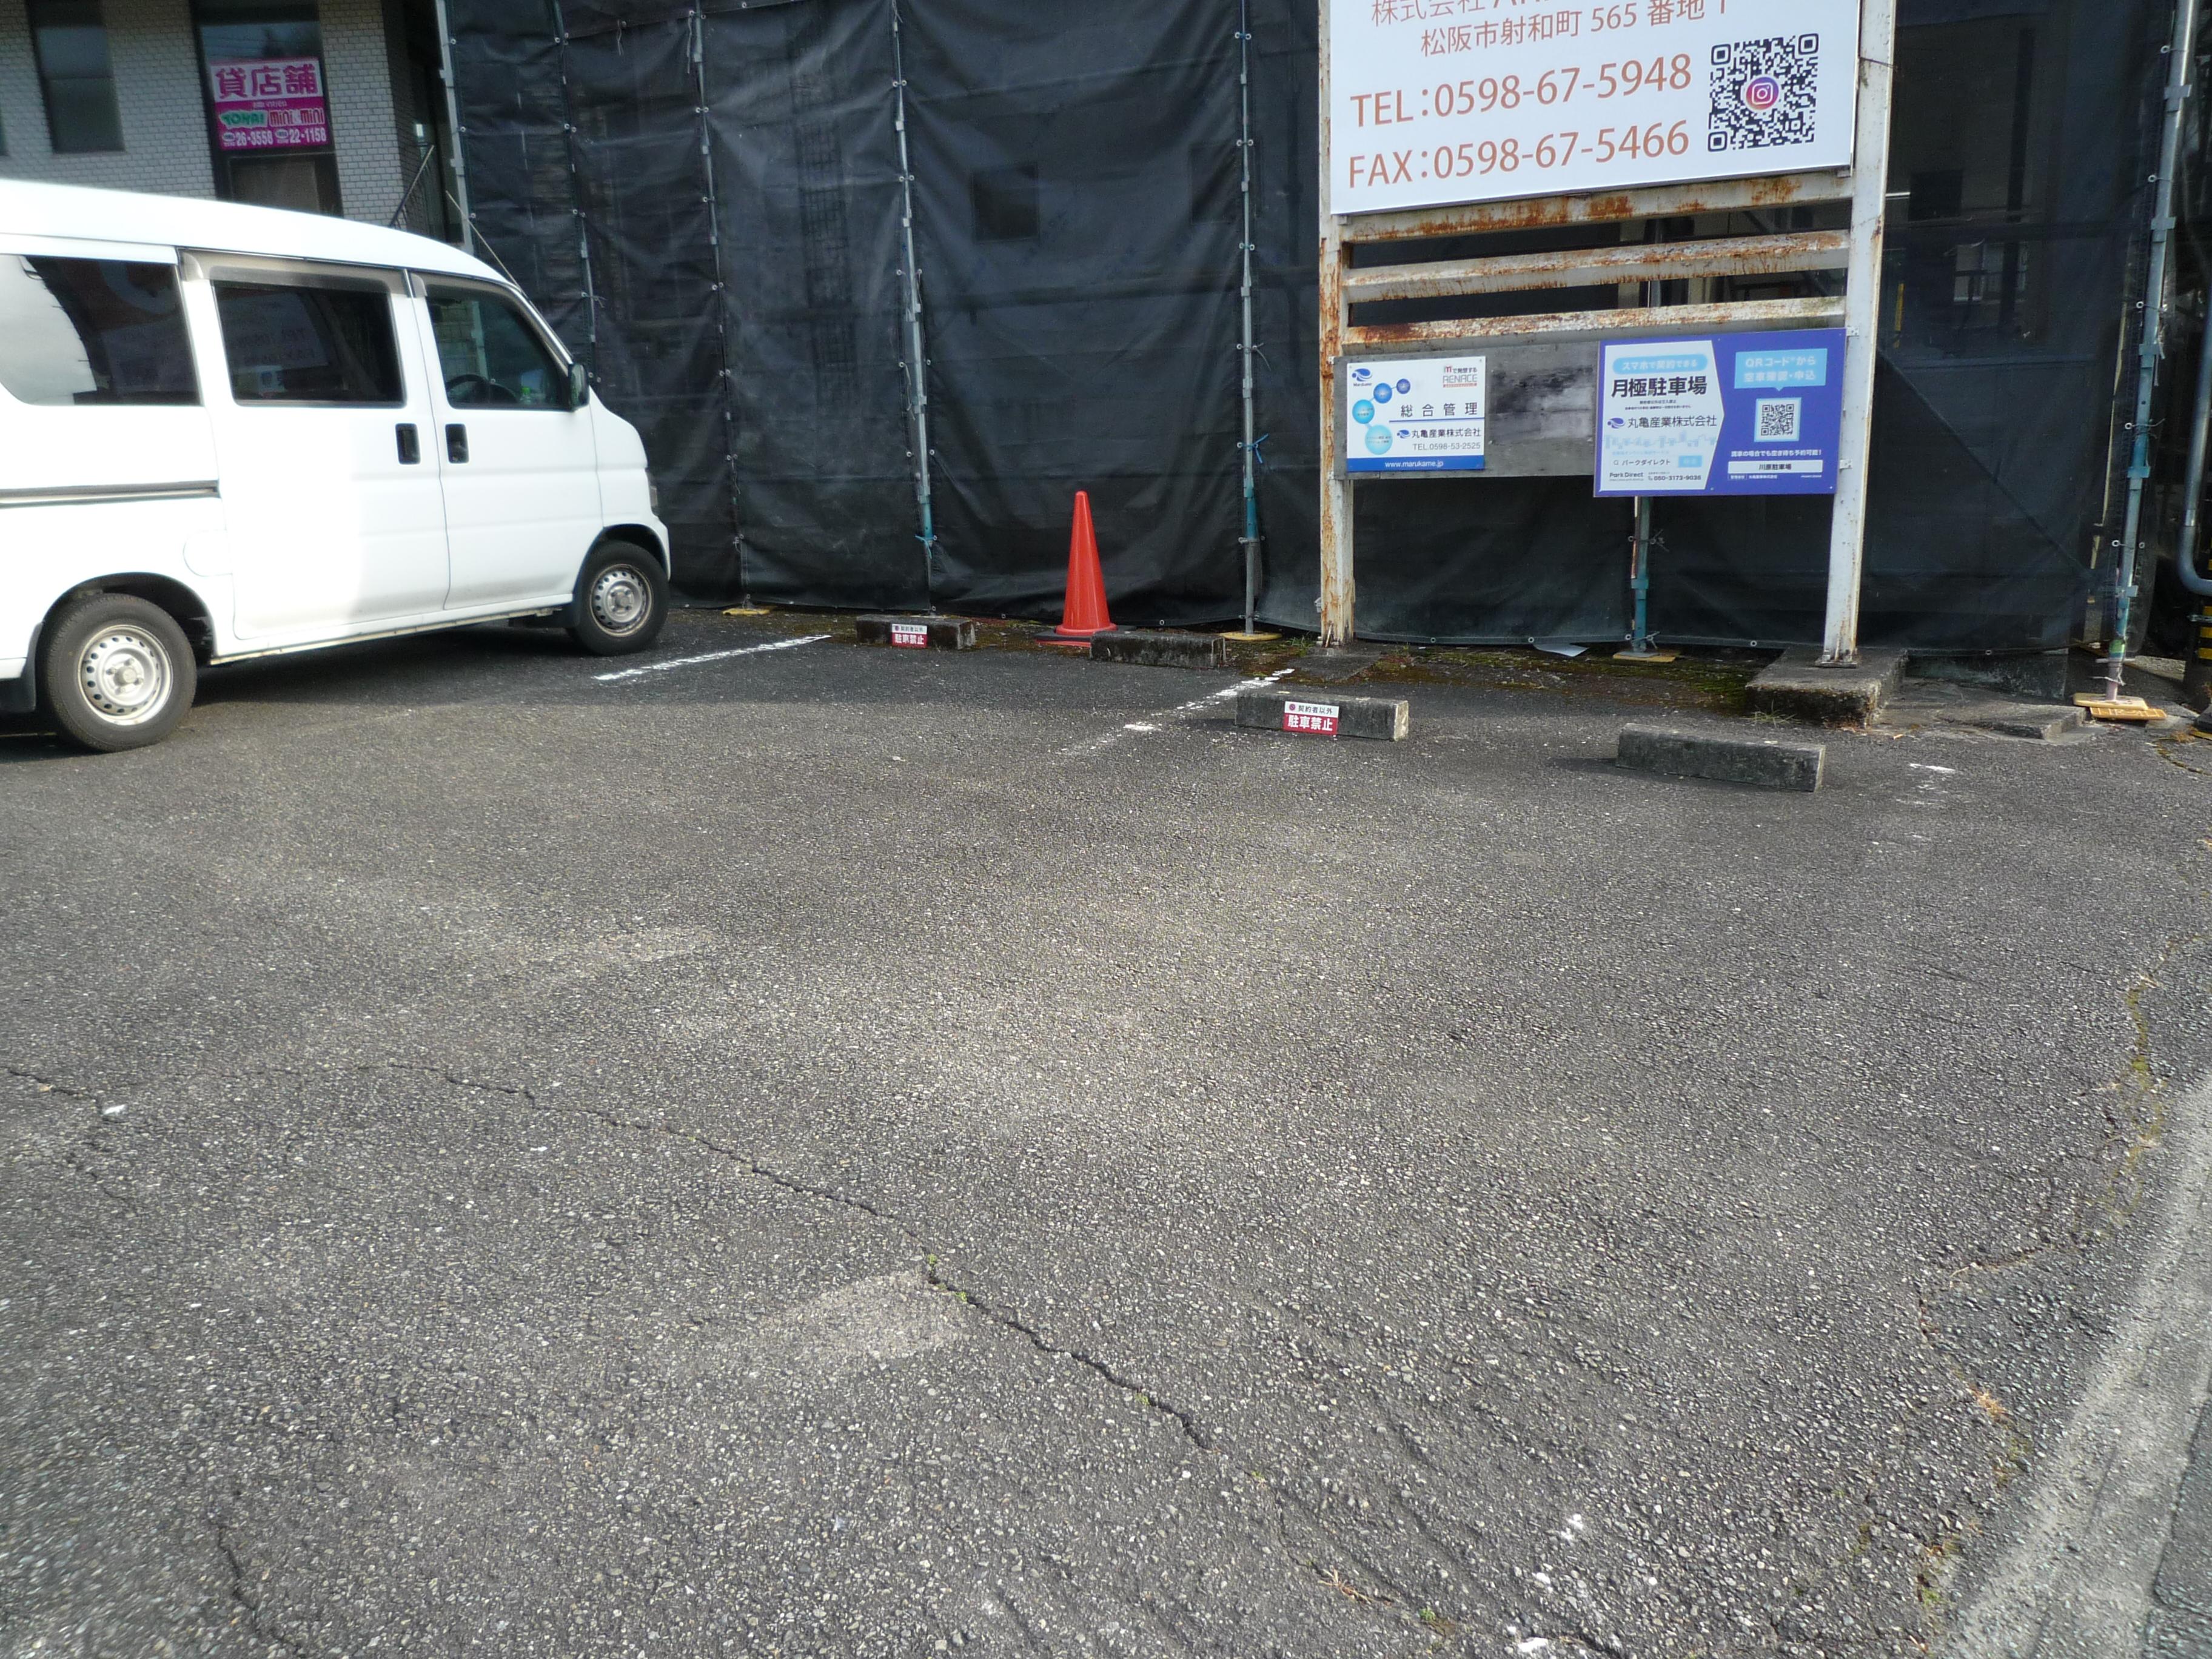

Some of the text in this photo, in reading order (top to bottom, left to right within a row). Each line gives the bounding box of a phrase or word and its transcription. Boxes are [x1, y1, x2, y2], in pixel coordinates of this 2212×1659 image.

[1421, 11, 1583, 57] 松阪市射和町
[1591, 3, 1637, 32] 565
[215, 63, 318, 99] 貸店舗
[1611, 375, 1708, 398] 月極駐車場
[1401, 402, 1478, 418] 総合管理
[1627, 415, 1717, 429] 丸亀産業株式会社
[1412, 428, 1481, 439] 丸亀産業株式会社
[894, 634, 925, 645] 駐車禁止
[1298, 705, 1333, 714] 契約者以外
[1287, 714, 1333, 731] 駐車禁止
